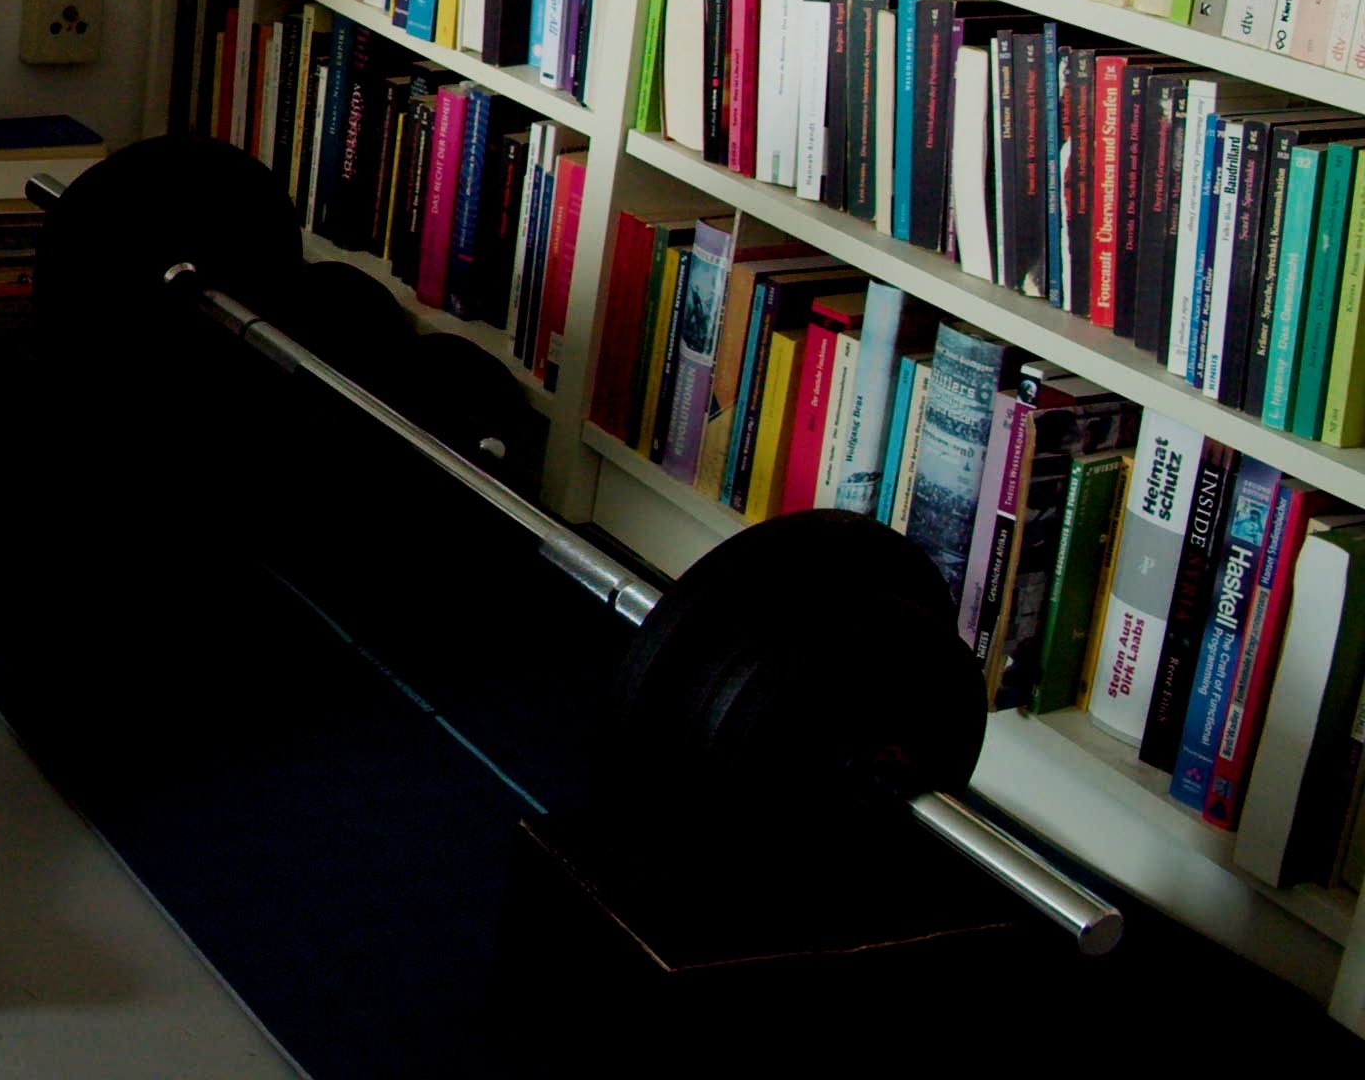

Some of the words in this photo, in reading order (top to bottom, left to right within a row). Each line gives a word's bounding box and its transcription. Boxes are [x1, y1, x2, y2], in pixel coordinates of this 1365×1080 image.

[549, 14, 559, 36] All
[1239, 12, 1254, 34] dtv
[439, 98, 451, 137] FREIHEIT
[1102, 88, 1119, 135] Strafen
[437, 139, 446, 159] DER
[1101, 138, 1116, 160] und
[1225, 136, 1240, 194] Baudrillard
[433, 160, 444, 192] RECHT
[1095, 164, 1117, 242] Überwachen
[1097, 251, 1112, 307] Foucault
[846, 420, 863, 462] Wolfgang
[1143, 436, 1169, 514] Heimat
[1159, 451, 1183, 520] schutz
[1189, 468, 1219, 548] INSIDE
[995, 528, 1009, 556] Afrikas
[987, 558, 1004, 602] Geschichte
[1214, 544, 1250, 629] Haskell
[1115, 612, 1133, 648] Aust
[1125, 618, 1145, 662] Laabs
[1224, 632, 1236, 648] The
[1107, 652, 1127, 698] Stefan
[1121, 666, 1136, 696] Dirk
[1197, 626, 1225, 695] Programming
[1215, 649, 1232, 677] Craft
[1213, 679, 1225, 690] of
[1200, 692, 1223, 746] Functional
